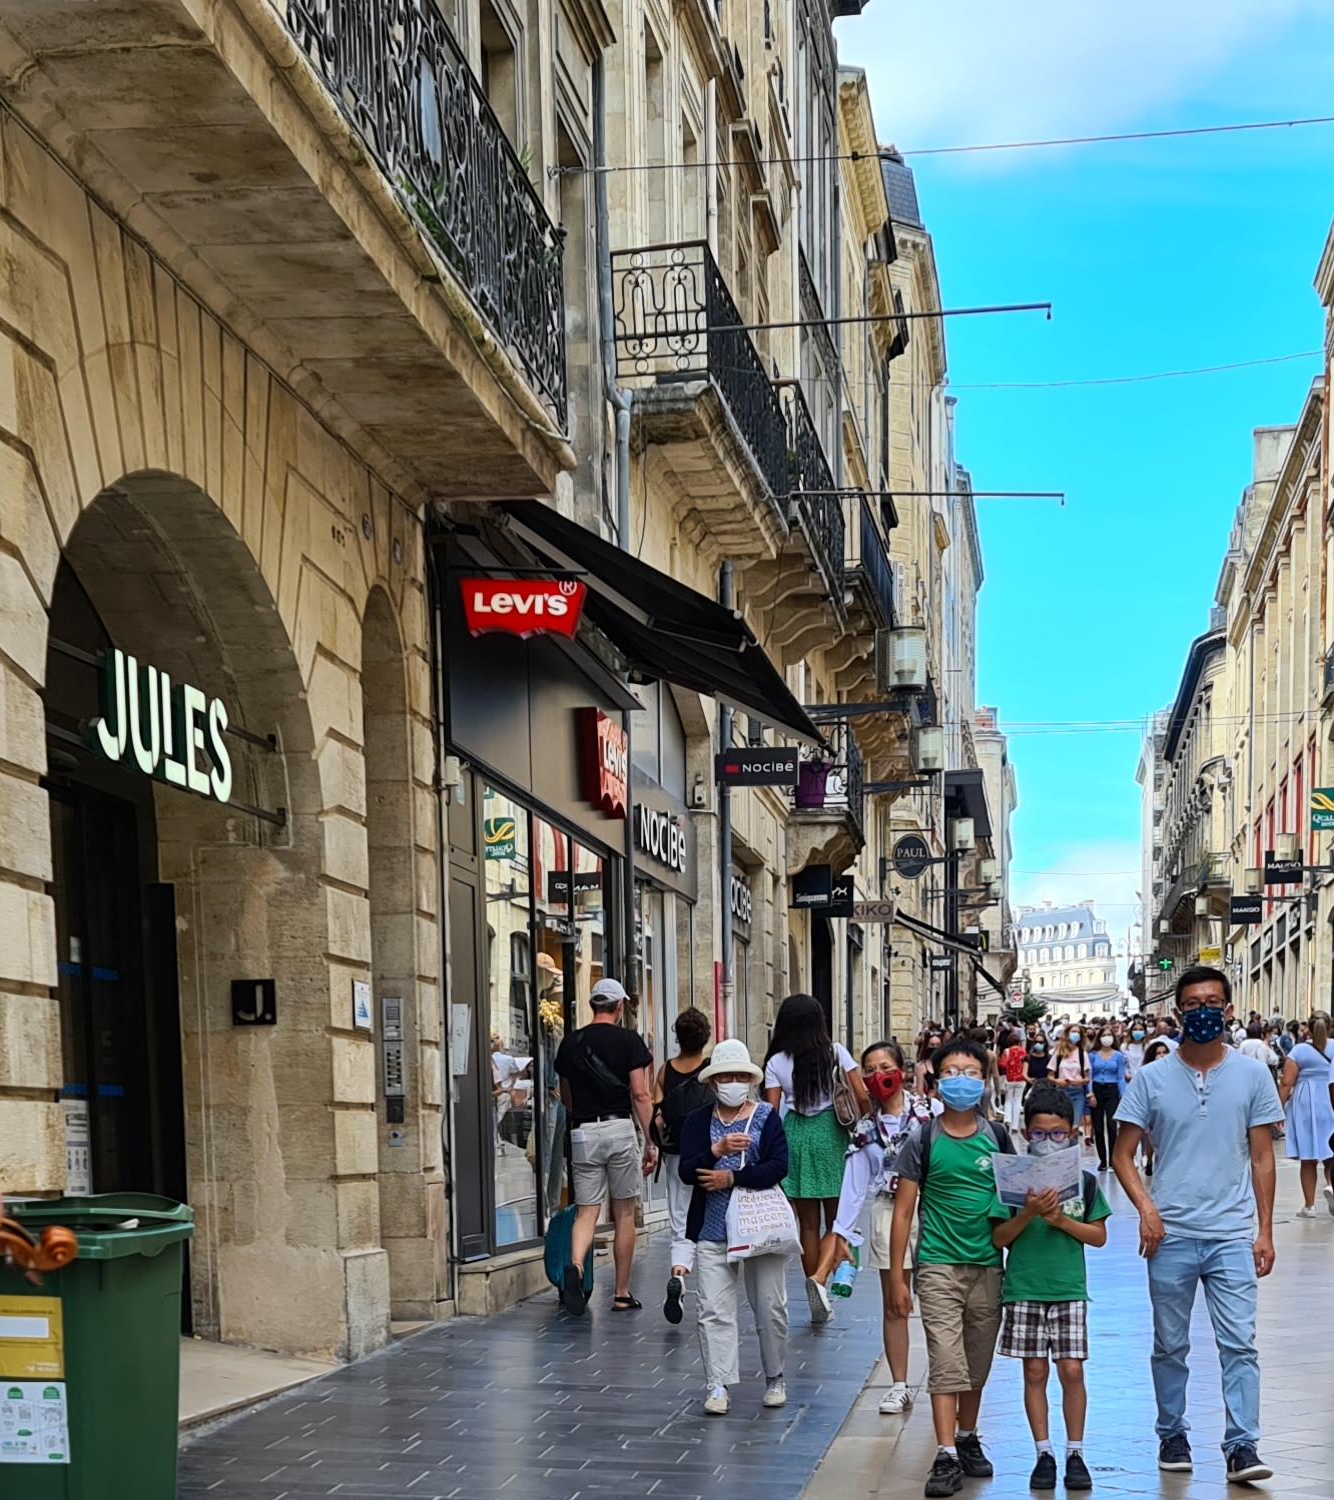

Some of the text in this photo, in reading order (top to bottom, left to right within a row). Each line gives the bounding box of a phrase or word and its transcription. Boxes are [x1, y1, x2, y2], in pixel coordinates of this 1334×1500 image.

[473, 591, 568, 616] Levi's
[97, 648, 233, 803] JULES
[896, 848, 926, 858] PAUL
[853, 904, 892, 917] KIKO
[739, 1212, 789, 1226] mascara
